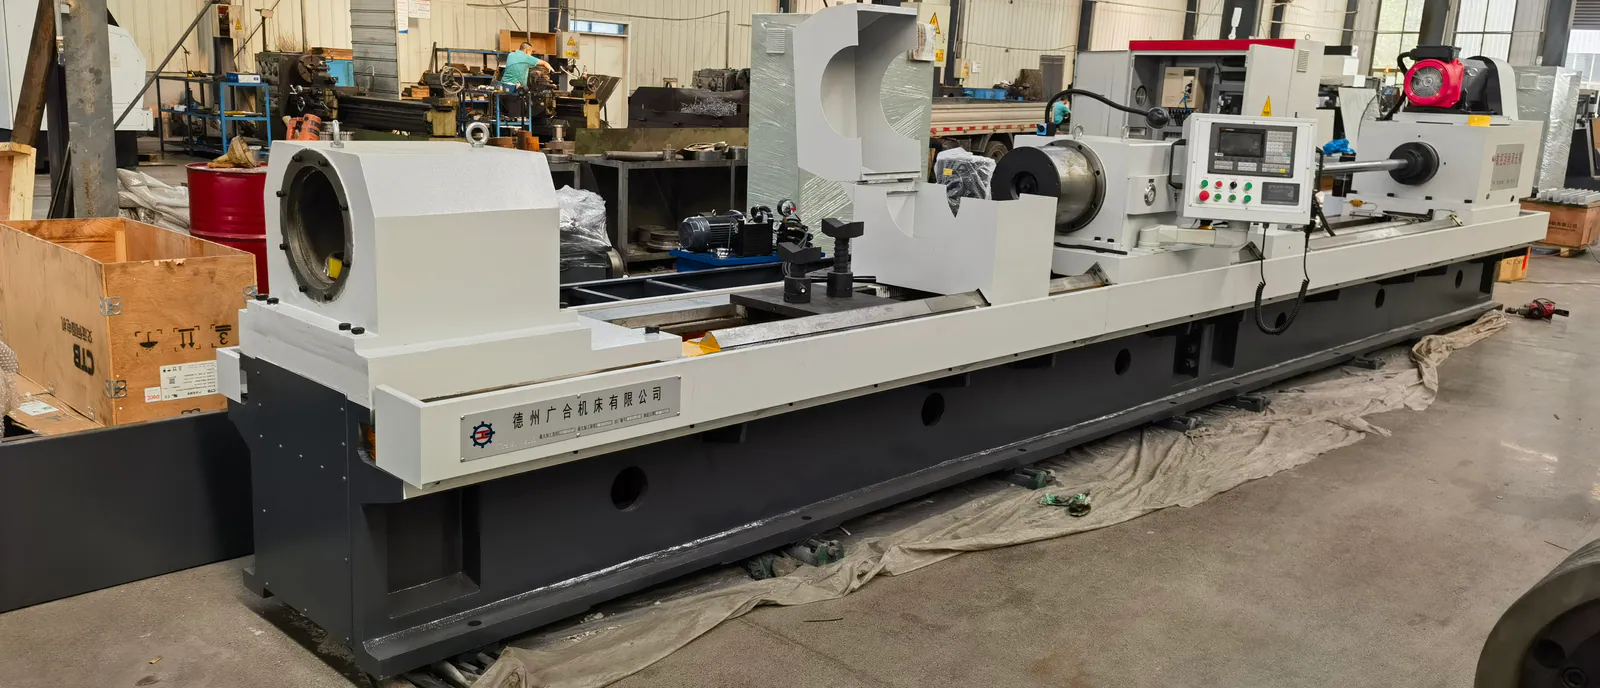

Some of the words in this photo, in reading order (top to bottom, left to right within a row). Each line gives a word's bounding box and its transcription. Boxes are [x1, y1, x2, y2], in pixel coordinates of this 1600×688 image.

[73, 343, 95, 376] CTB
[512, 386, 662, 430] 德州广合机床有限公司
